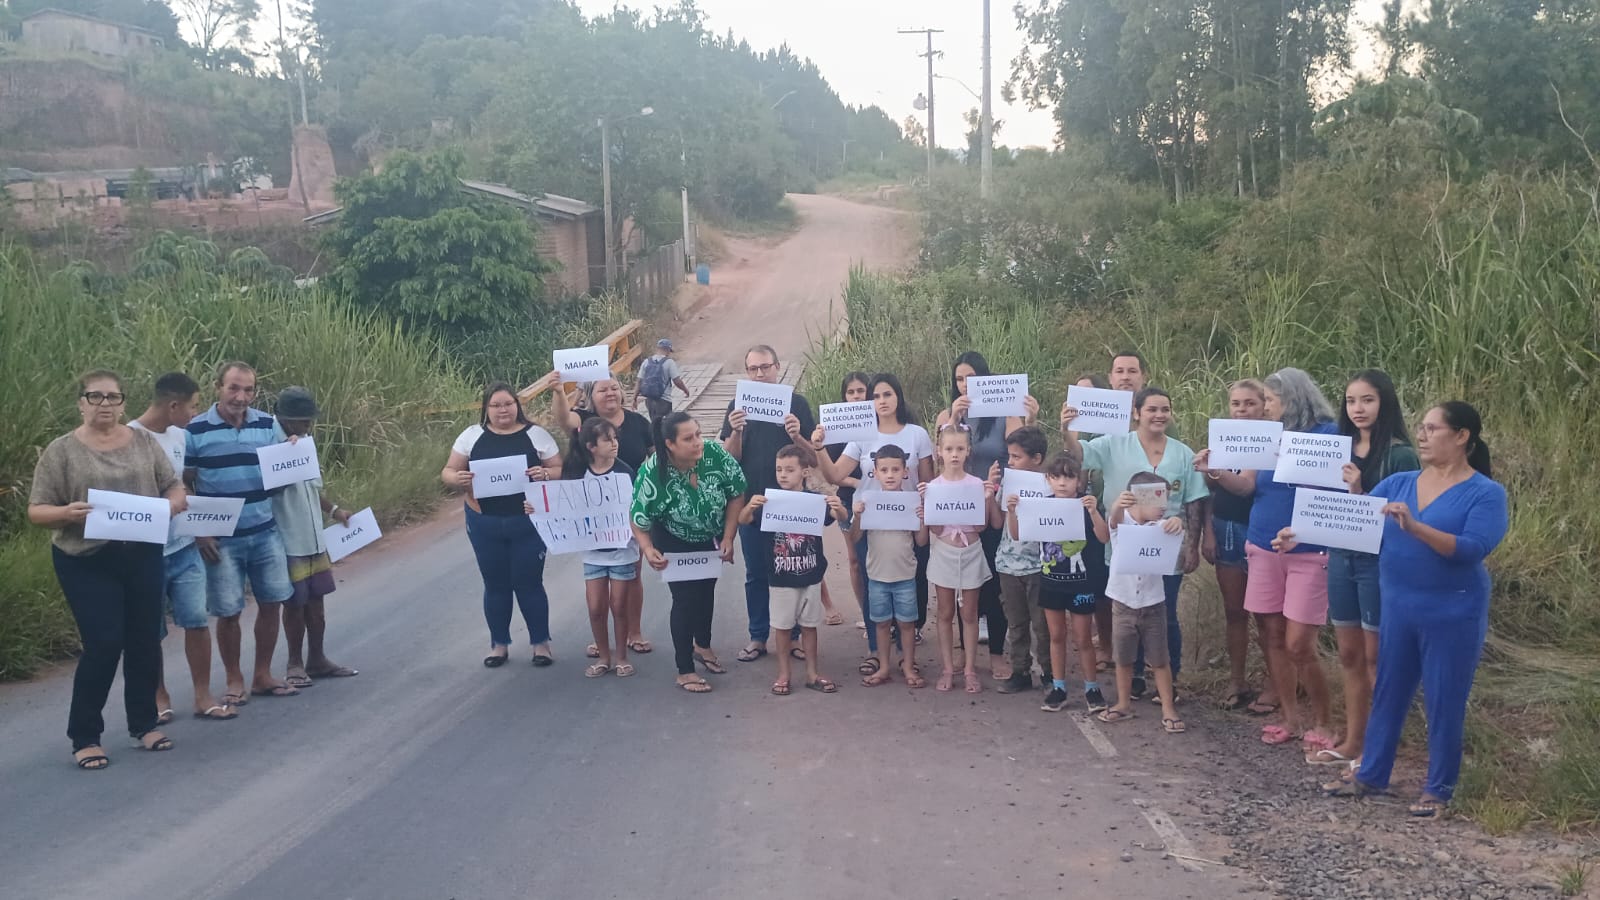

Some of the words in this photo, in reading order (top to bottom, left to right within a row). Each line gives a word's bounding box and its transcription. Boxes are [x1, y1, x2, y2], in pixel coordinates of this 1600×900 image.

[565, 359, 599, 370] MAIARA
[742, 393, 785, 406] Motorista:
[838, 405, 844, 413] A
[844, 404, 872, 413] ENTRADA
[1081, 400, 1119, 410] QUEREMOS
[742, 405, 784, 417] RONALDO
[832, 414, 855, 422] ESCOLA
[1250, 435, 1272, 443] NADA
[1291, 437, 1332, 448] QUEREMOS
[1333, 440, 1340, 448] O
[1225, 445, 1238, 453] FOI
[1287, 447, 1343, 459] ATERRAMENTO
[272, 456, 310, 472] IZABELLY
[1296, 459, 1318, 468] LOGO
[490, 474, 512, 483] DAVI
[935, 500, 976, 511] NATÁLIA
[1313, 495, 1358, 506] MOVIMENTO
[876, 503, 905, 512] DIEGO
[1307, 503, 1354, 514] HOMENAGEM
[107, 511, 152, 523] VICTOR
[187, 513, 232, 522] STEFFANY
[1039, 518, 1065, 526] LIVIA
[1300, 510, 1333, 520] CRIANÇAS
[1346, 516, 1379, 526] ACIDENTE
[1313, 520, 1322, 528] DE
[341, 527, 363, 543] ERICA
[1138, 547, 1162, 557] ALEX
[677, 557, 708, 566] DIOGO
